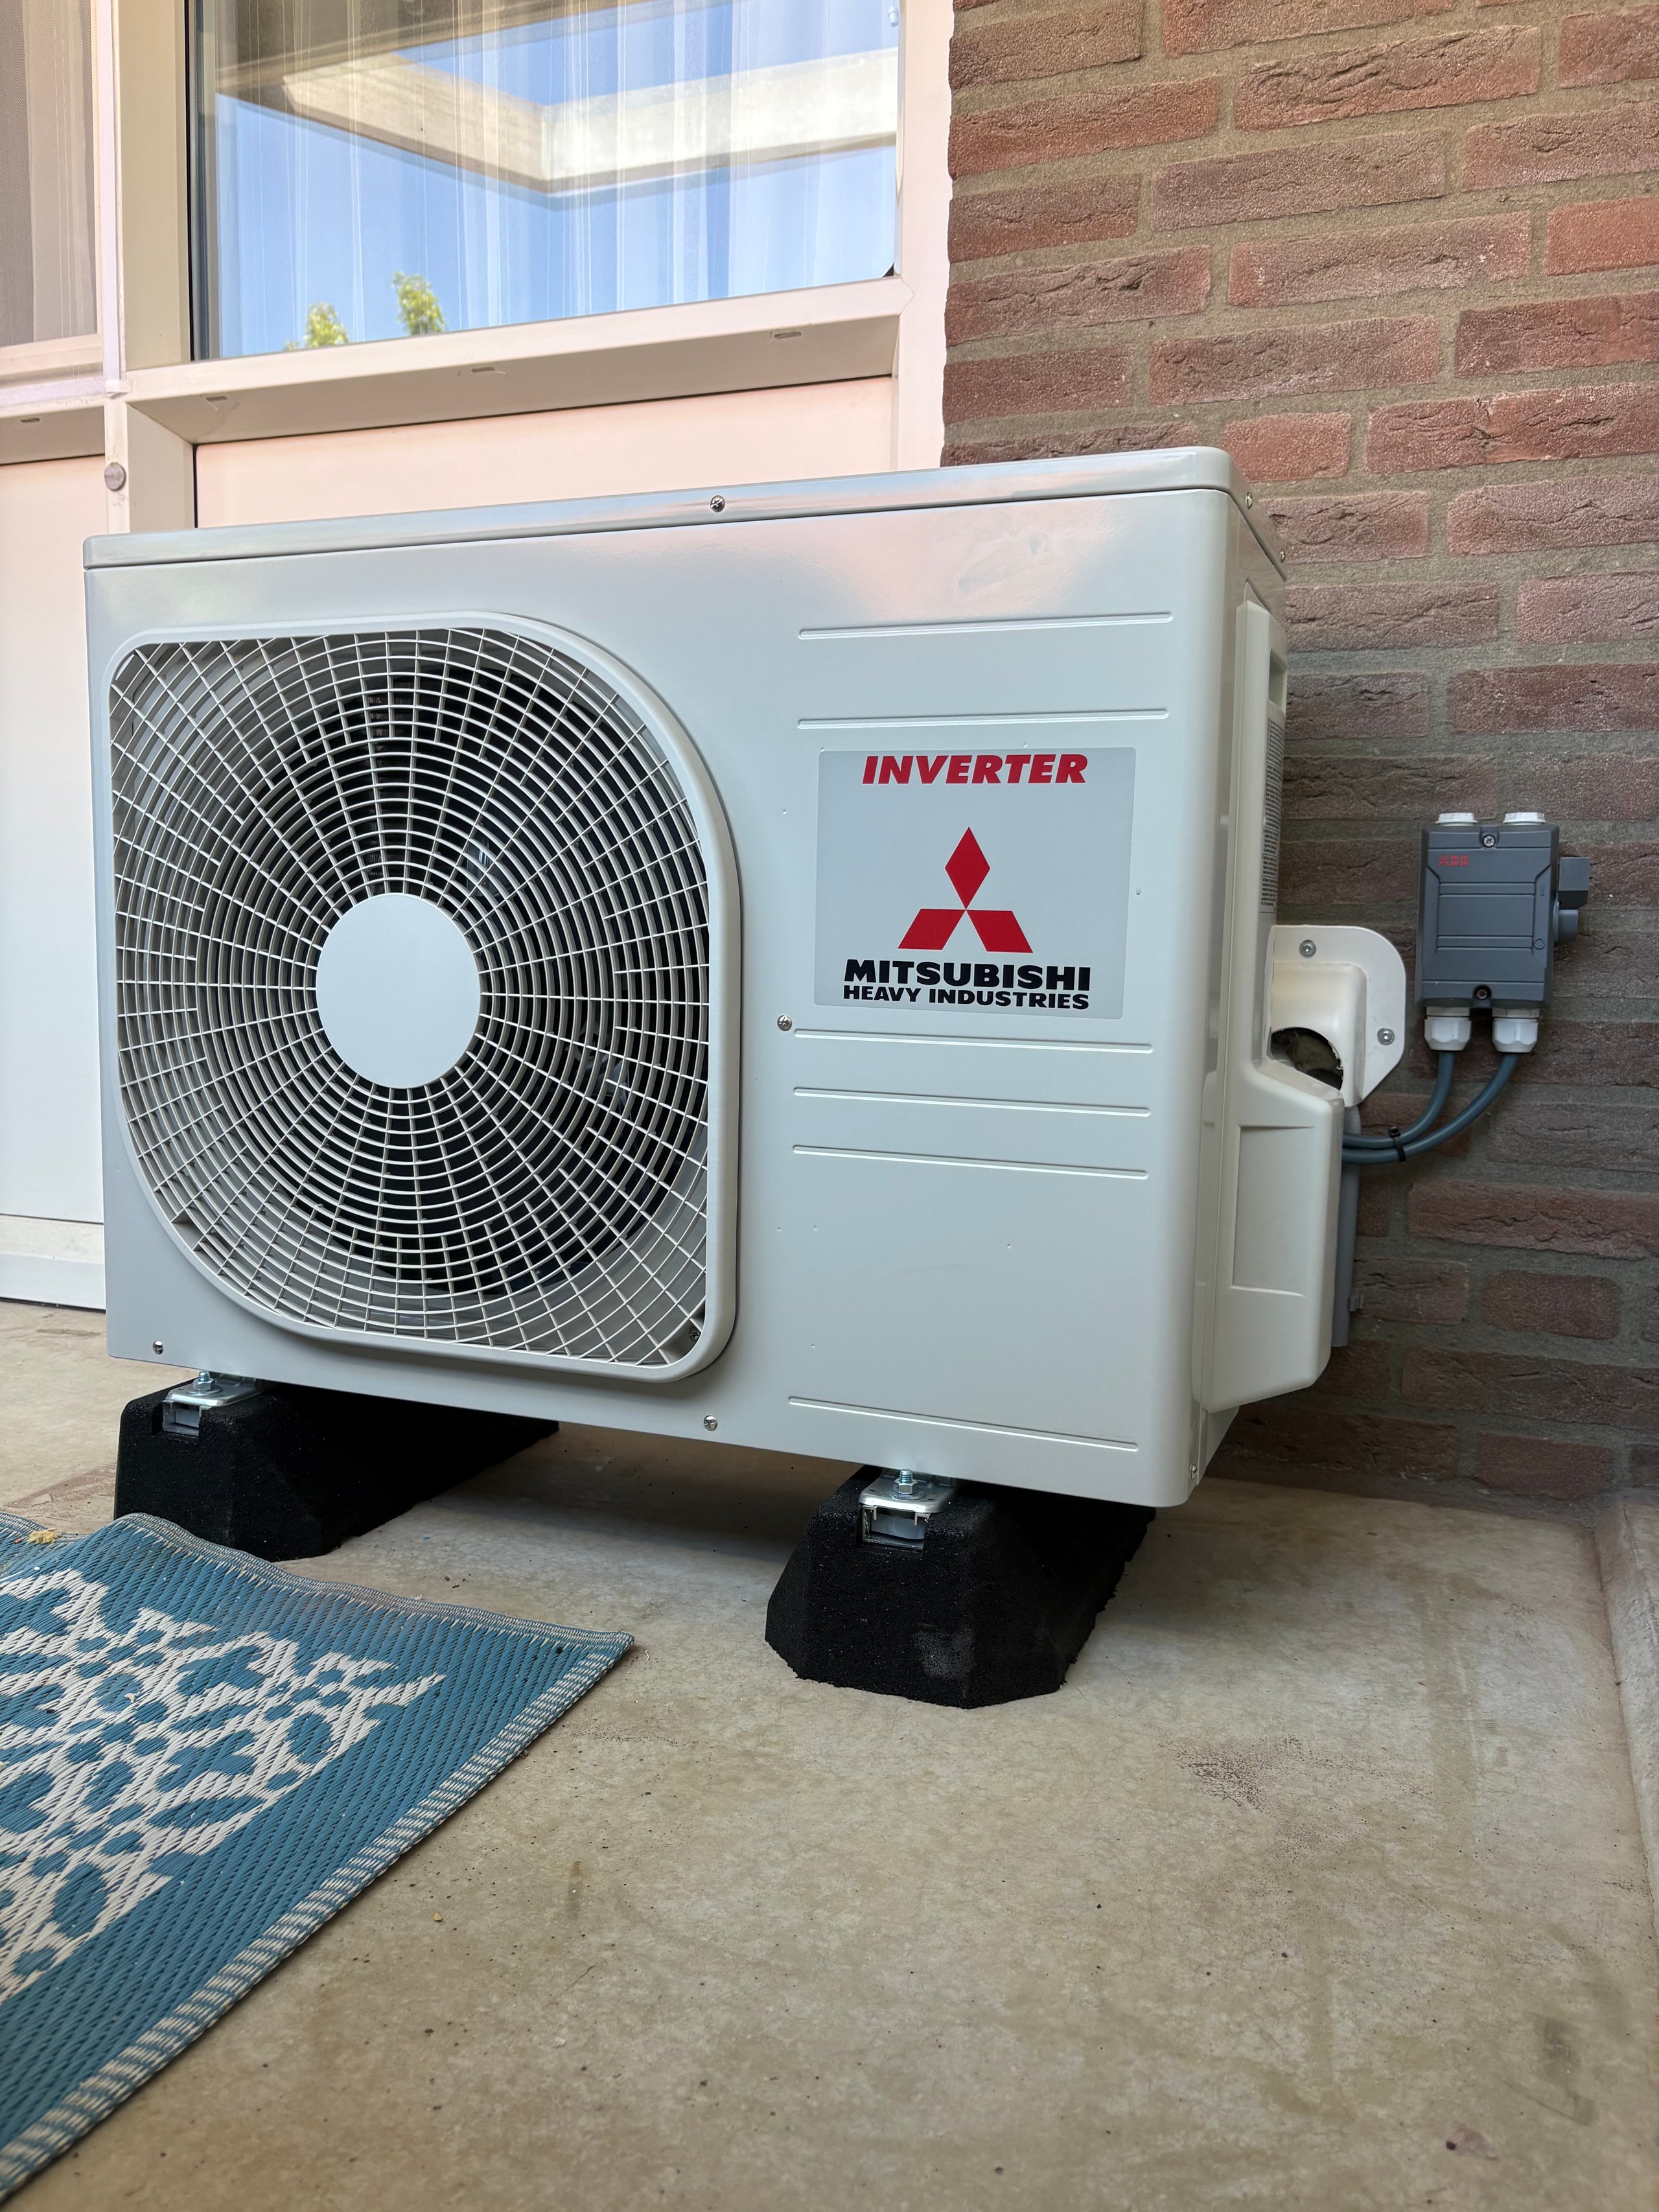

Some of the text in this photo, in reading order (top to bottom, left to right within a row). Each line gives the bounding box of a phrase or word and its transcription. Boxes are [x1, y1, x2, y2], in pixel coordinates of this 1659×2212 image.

[863, 754, 1088, 784] INVERTER
[1437, 854, 1469, 867] ABB
[844, 959, 1091, 992] MITSUBISHI
[843, 984, 1089, 1010] HEAVY INDUSTRIES
